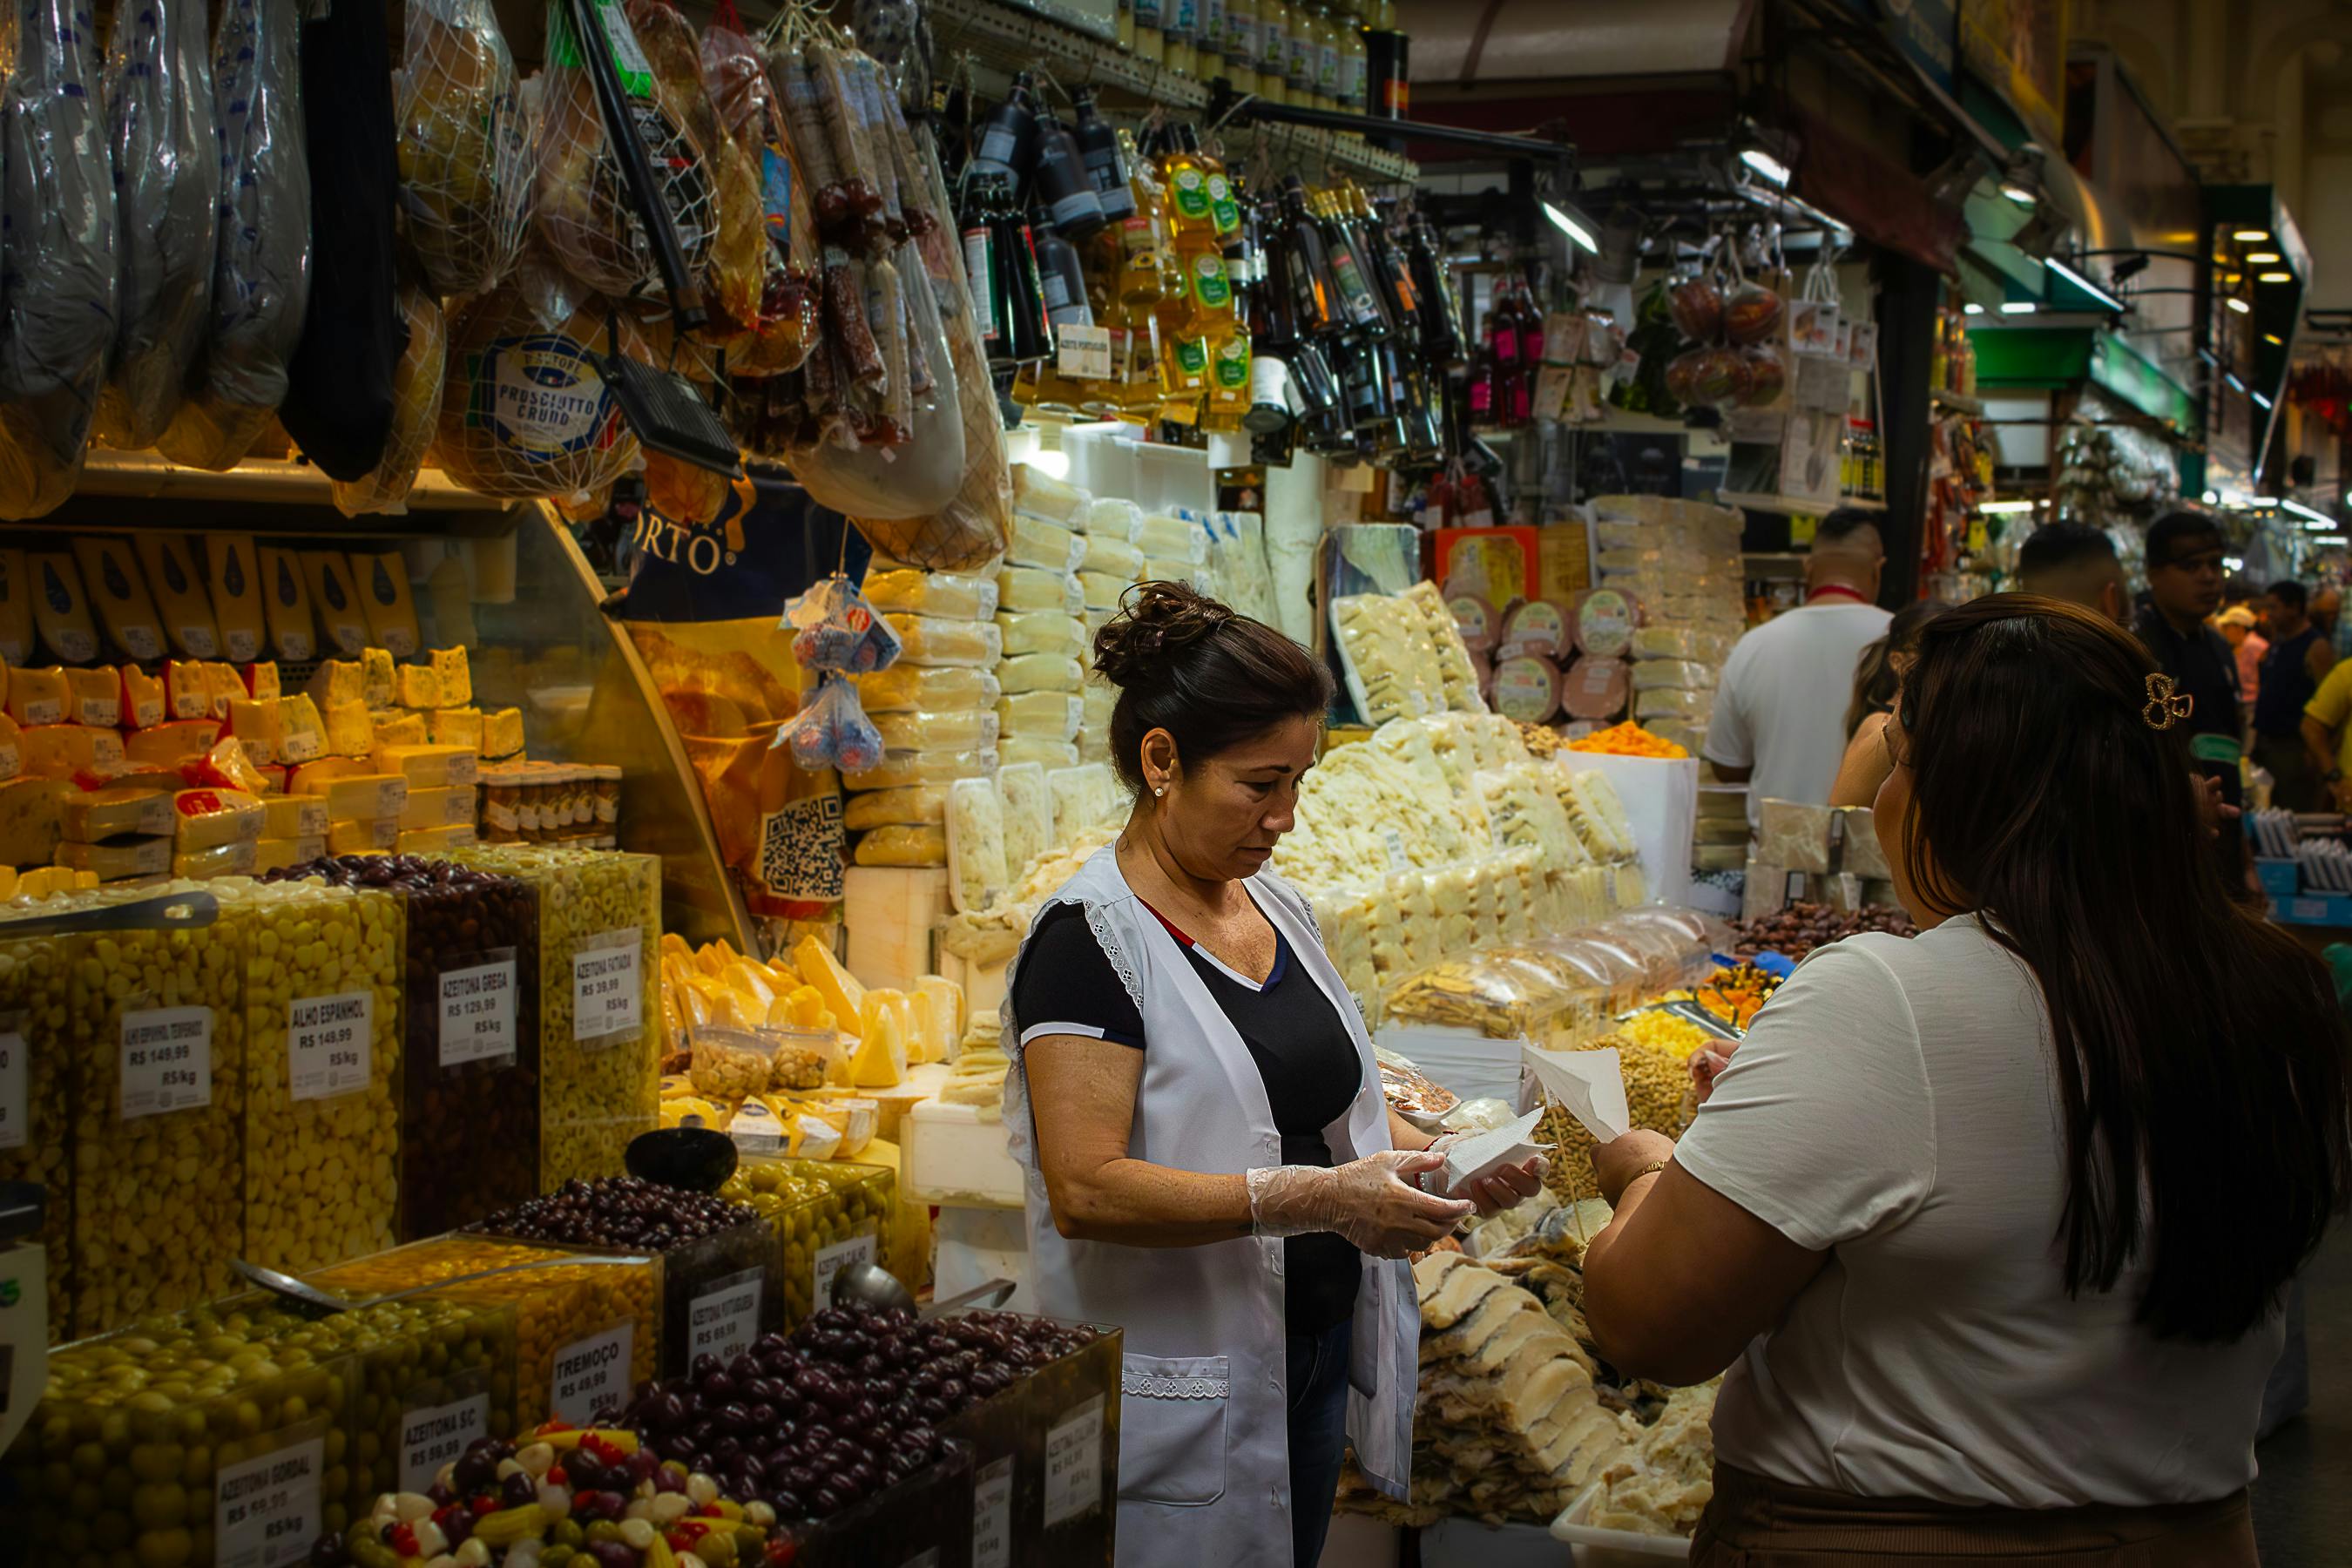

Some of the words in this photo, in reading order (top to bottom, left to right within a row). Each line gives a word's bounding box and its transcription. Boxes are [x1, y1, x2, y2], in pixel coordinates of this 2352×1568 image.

[500, 384, 594, 416] PROSCIUTTO
[517, 404, 569, 426] CRUDO
[576, 959, 607, 980] AZEITONA
[442, 976, 480, 998] AZEITONA
[482, 971, 508, 992] GREGA
[293, 1006, 318, 1029] ALHO
[320, 998, 365, 1024] ESPANHOL
[464, 997, 496, 1014] 129,99
[318, 1028, 352, 1046] 149,99
[150, 1045, 189, 1063] 149,99
[556, 1342, 619, 1381] TREMOÇO
[578, 1370, 607, 1391] 49,99
[403, 1414, 457, 1448] AZEITONA
[220, 1468, 268, 1504] AZEITONA
